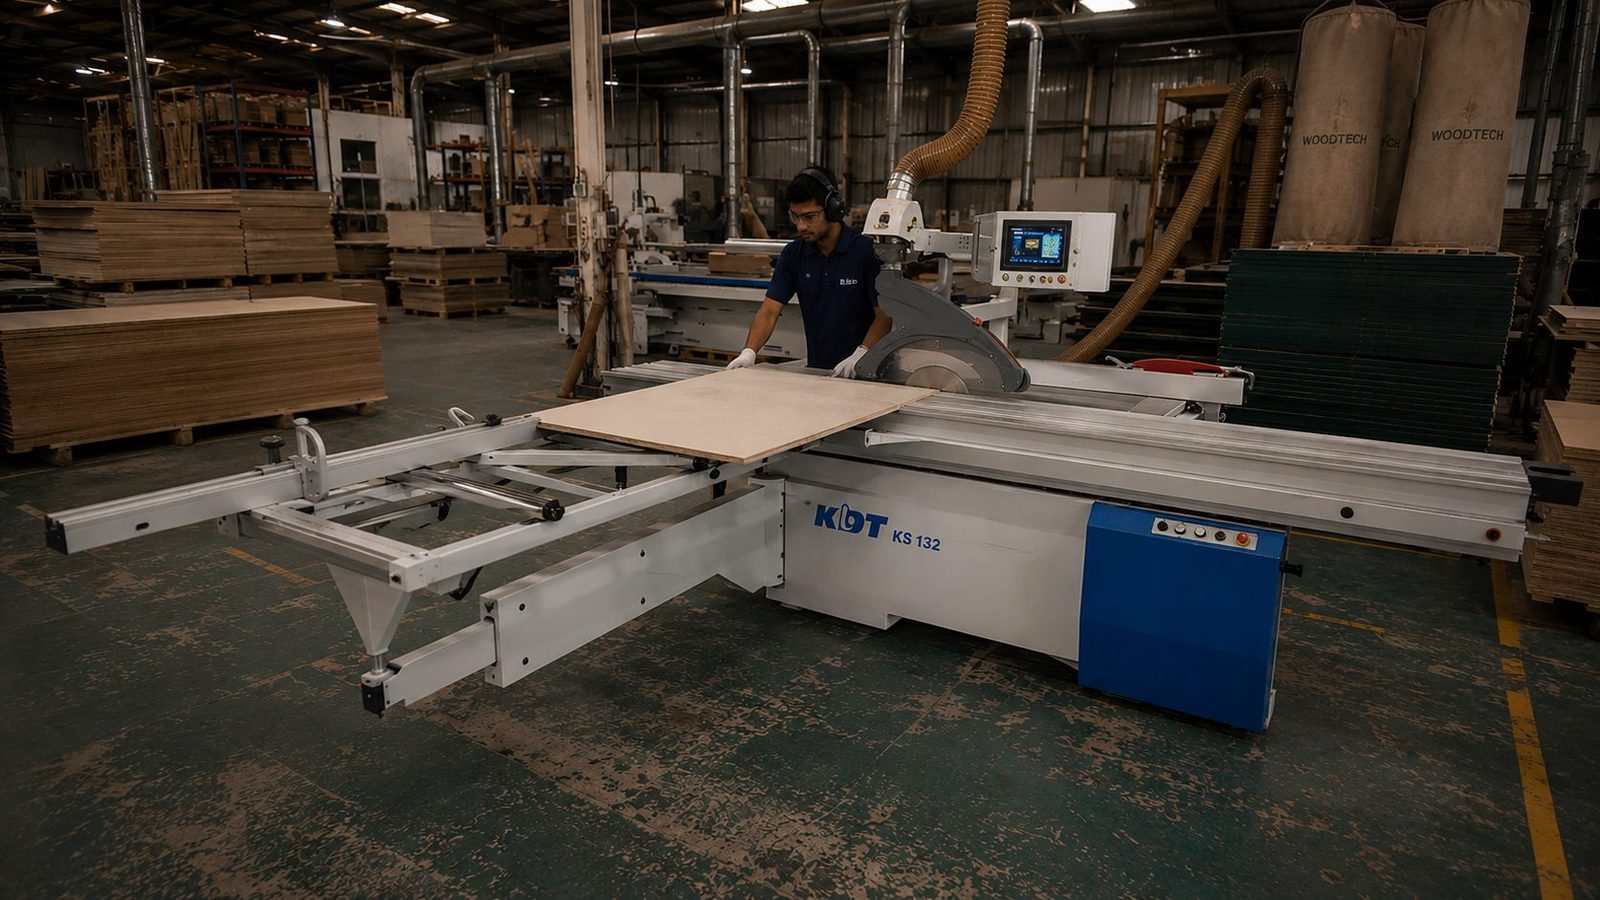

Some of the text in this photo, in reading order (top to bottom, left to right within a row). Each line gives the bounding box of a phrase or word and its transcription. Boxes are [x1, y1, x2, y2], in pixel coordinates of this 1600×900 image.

[1302, 133, 1368, 146] WOODTECH
[1432, 129, 1504, 141] WOODTECH
[892, 530, 912, 545] KS
[916, 535, 941, 551] 132
